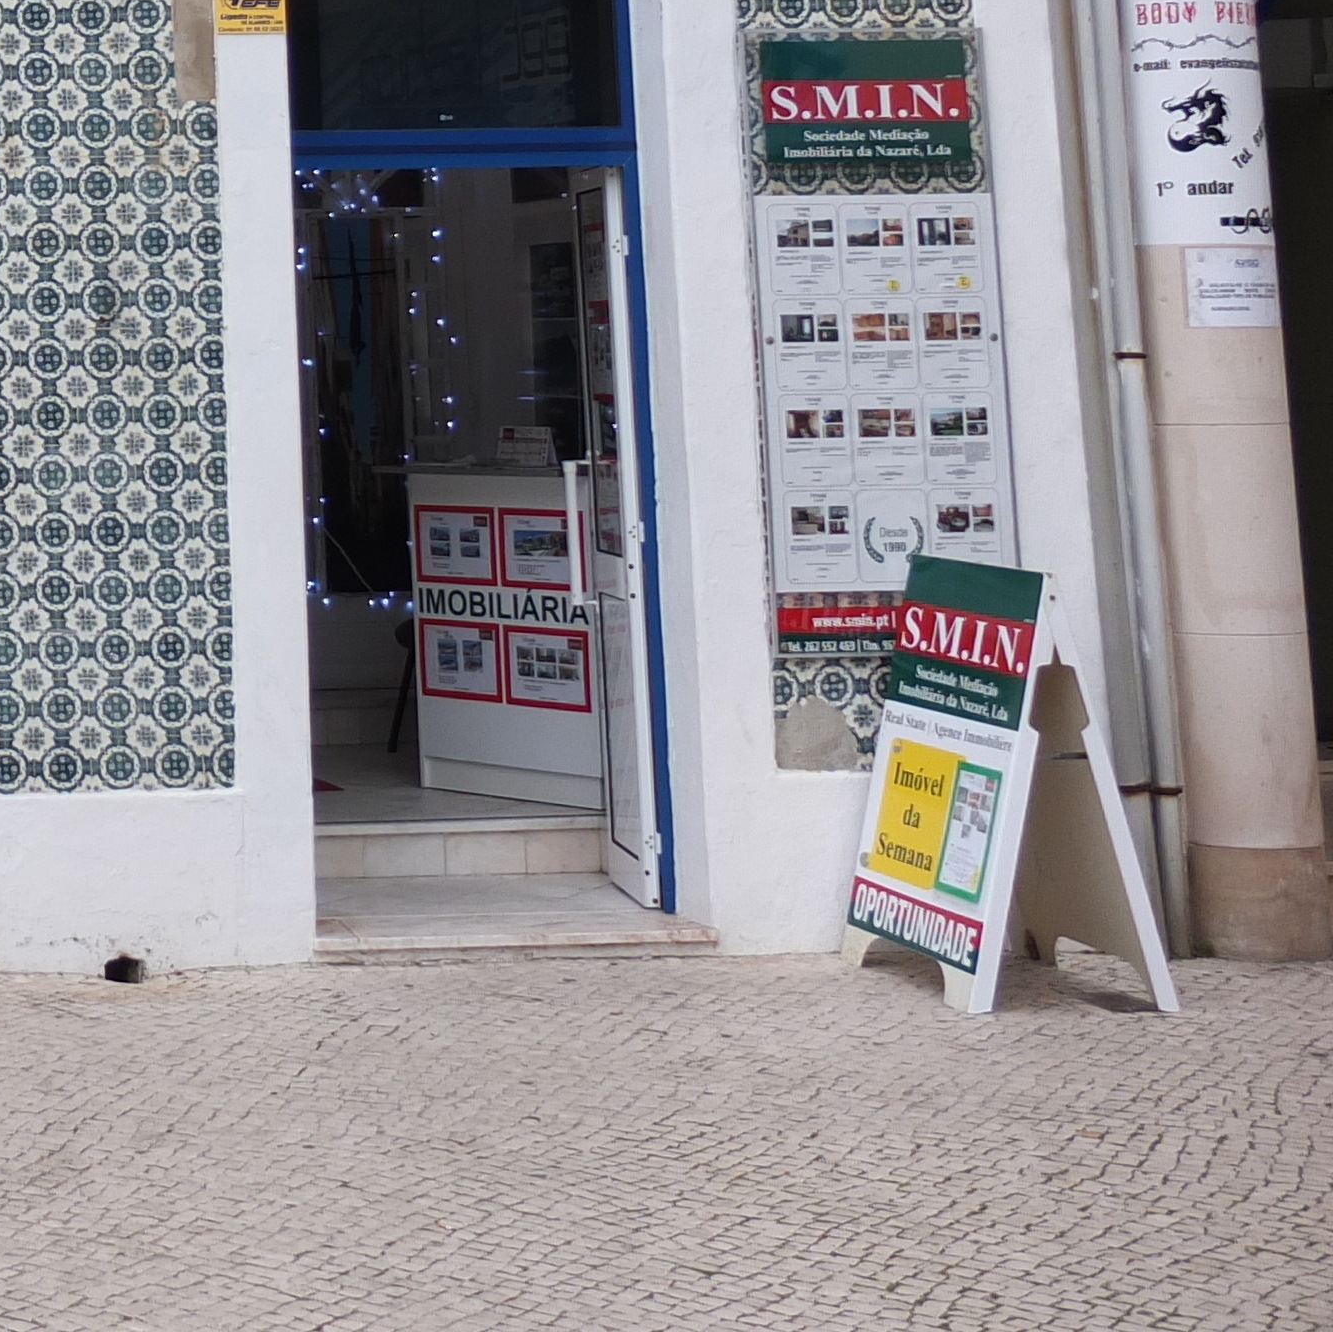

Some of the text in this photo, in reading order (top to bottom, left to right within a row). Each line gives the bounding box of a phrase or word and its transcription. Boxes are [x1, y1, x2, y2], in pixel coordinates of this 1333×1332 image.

[1135, 1, 1196, 26] BODY
[770, 83, 959, 120] S.M.I.N.
[803, 128, 929, 143] Sociedade Mediação
[856, 145, 873, 157] da
[875, 144, 924, 157] Nazaré,
[926, 144, 952, 156] Lda
[1187, 180, 1234, 195] andar
[879, 527, 908, 537] Desde
[883, 542, 906, 552] 1990
[418, 587, 590, 626] IMOBILIÁRIA
[901, 606, 1024, 673] S.M.I.N.
[915, 664, 957, 687] Sociedade
[946, 693, 957, 708] da
[885, 709, 904, 725] Real
[893, 761, 945, 797] Imóvel
[903, 803, 920, 829] da
[876, 832, 932, 872] Semana
[853, 883, 978, 968] OPORTUNIDADE
